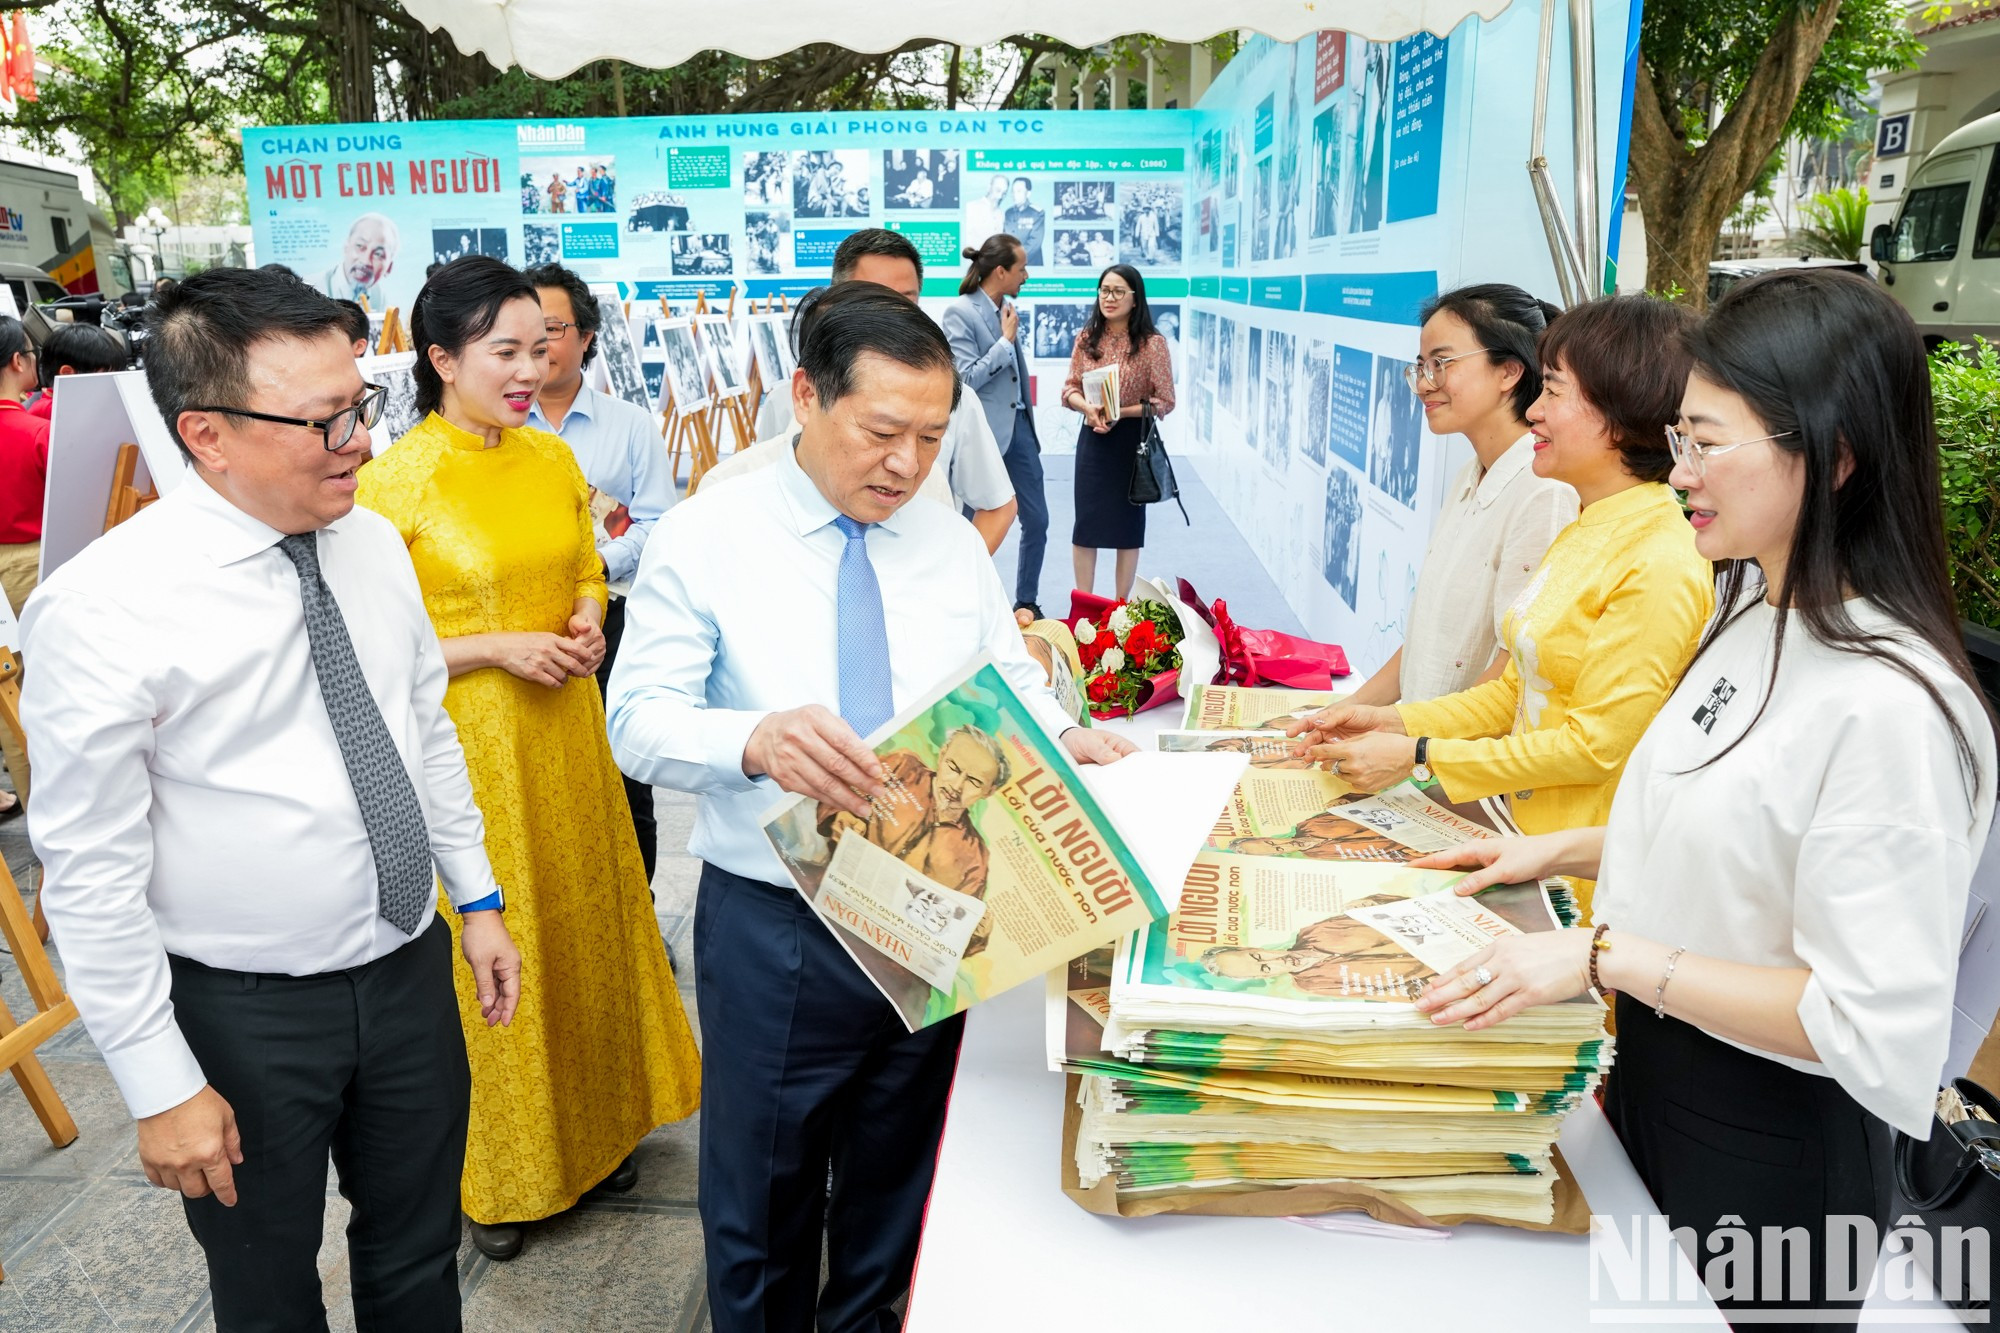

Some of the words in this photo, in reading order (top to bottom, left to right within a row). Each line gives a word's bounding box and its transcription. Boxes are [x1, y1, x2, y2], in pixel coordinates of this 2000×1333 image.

[1882, 122, 1903, 151] B
[265, 158, 322, 202] MỘT
[337, 161, 395, 197] CON
[409, 150, 501, 194] NGƯỜI
[1420, 804, 1458, 826] NHÂN
[1015, 765, 1069, 821] LỜI
[1052, 817, 1133, 915] NGƯỜI
[1229, 866, 1239, 886] non
[821, 894, 859, 924] DÂN
[1071, 890, 1100, 924] non
[1170, 920, 1217, 943] LỜI
[1466, 911, 1513, 936] NHÂ
[859, 918, 912, 961] NHÂN
